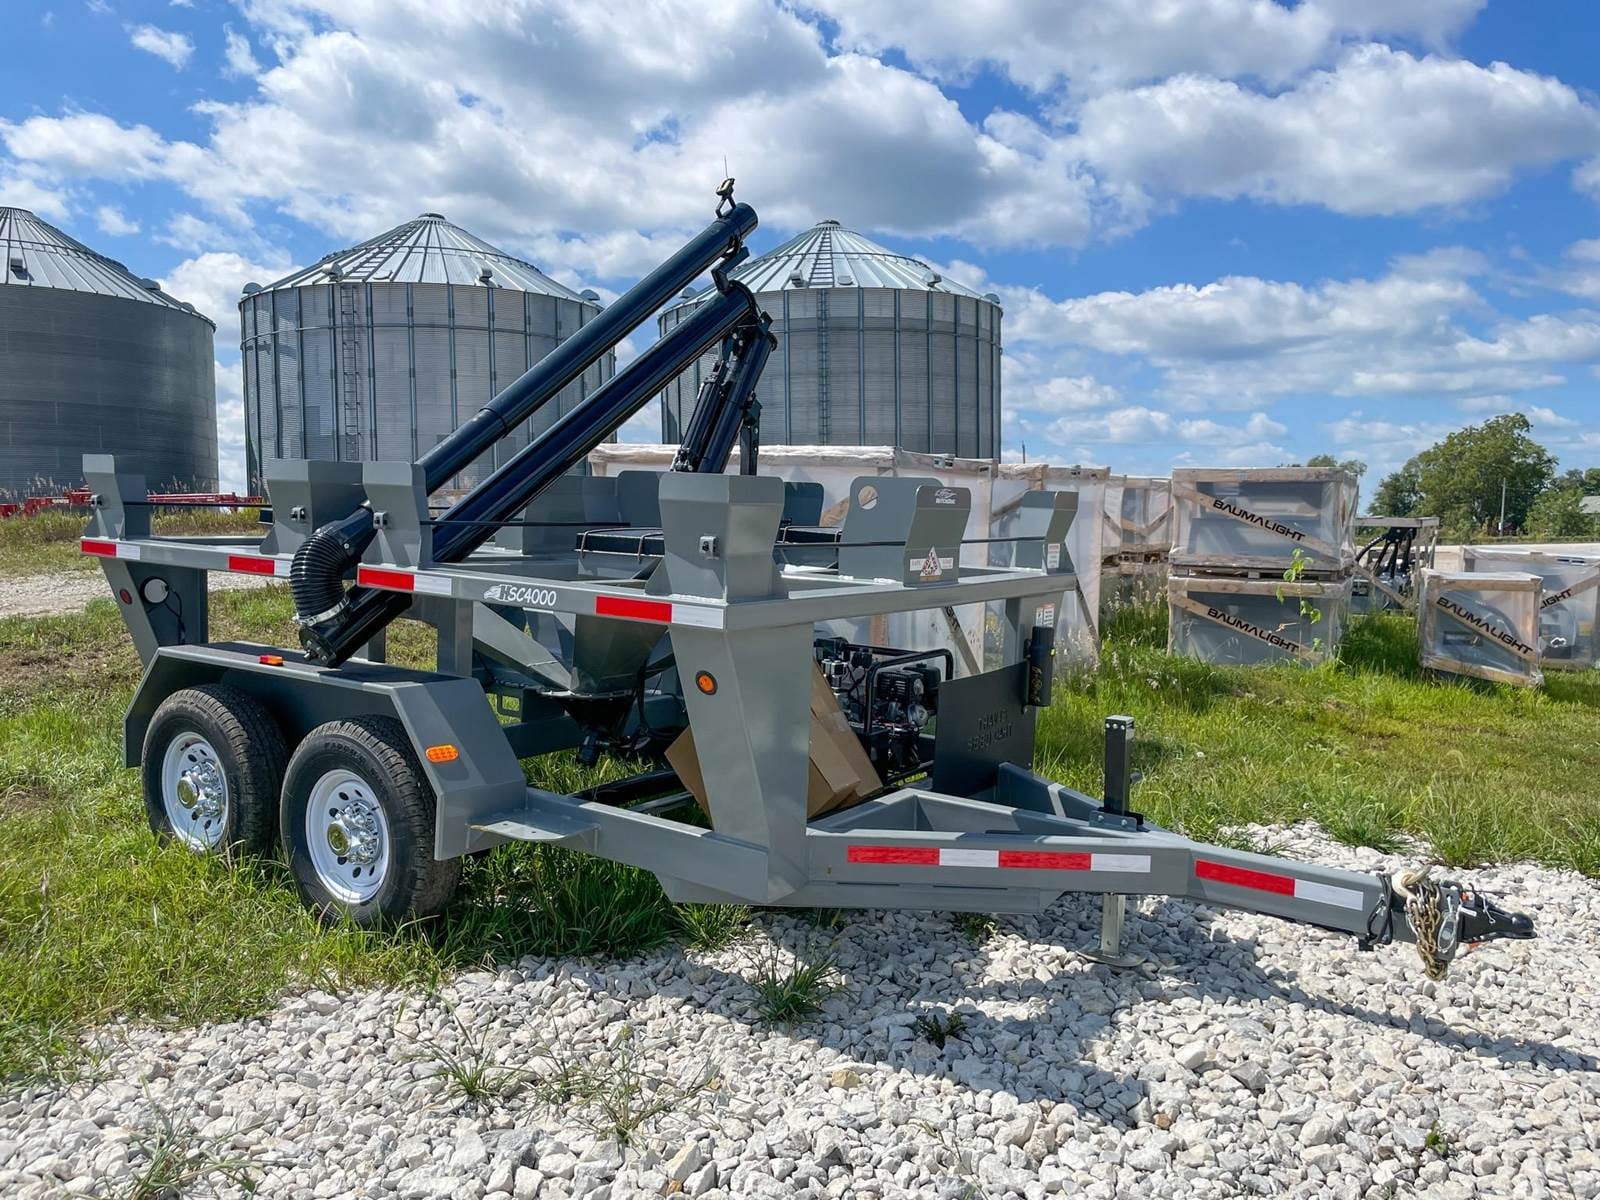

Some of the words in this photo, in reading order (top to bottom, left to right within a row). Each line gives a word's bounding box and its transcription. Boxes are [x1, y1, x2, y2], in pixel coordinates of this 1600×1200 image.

[1213, 499, 1306, 541] BAUMALIGHT
[1207, 607, 1300, 652] BAUMALIGHT
[1436, 596, 1533, 655] BAUMALIGHT
